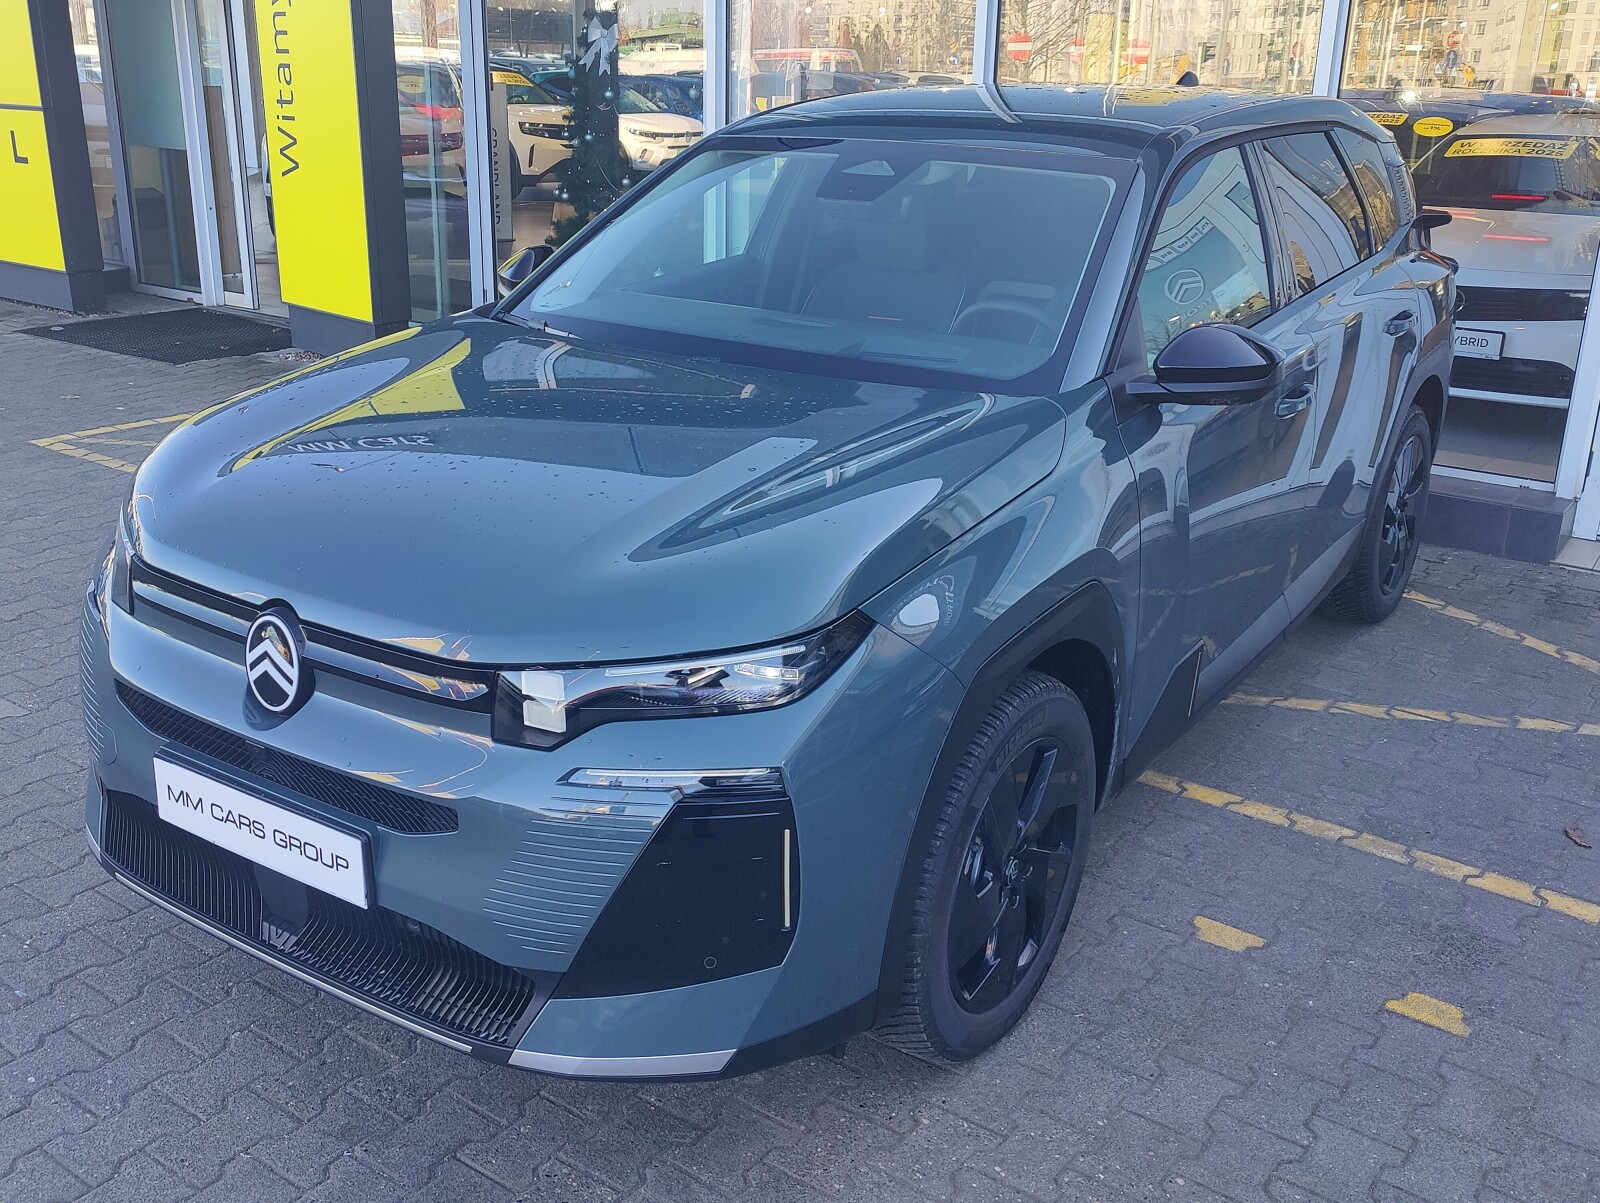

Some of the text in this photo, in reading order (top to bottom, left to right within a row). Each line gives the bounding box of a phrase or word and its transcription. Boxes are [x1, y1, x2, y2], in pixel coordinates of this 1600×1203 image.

[1460, 140, 1569, 150] WRZEDAŻ
[1525, 149, 1564, 157] 2025
[1454, 335, 1489, 348] YBRID
[167, 784, 349, 871] MM CARS GROUP
